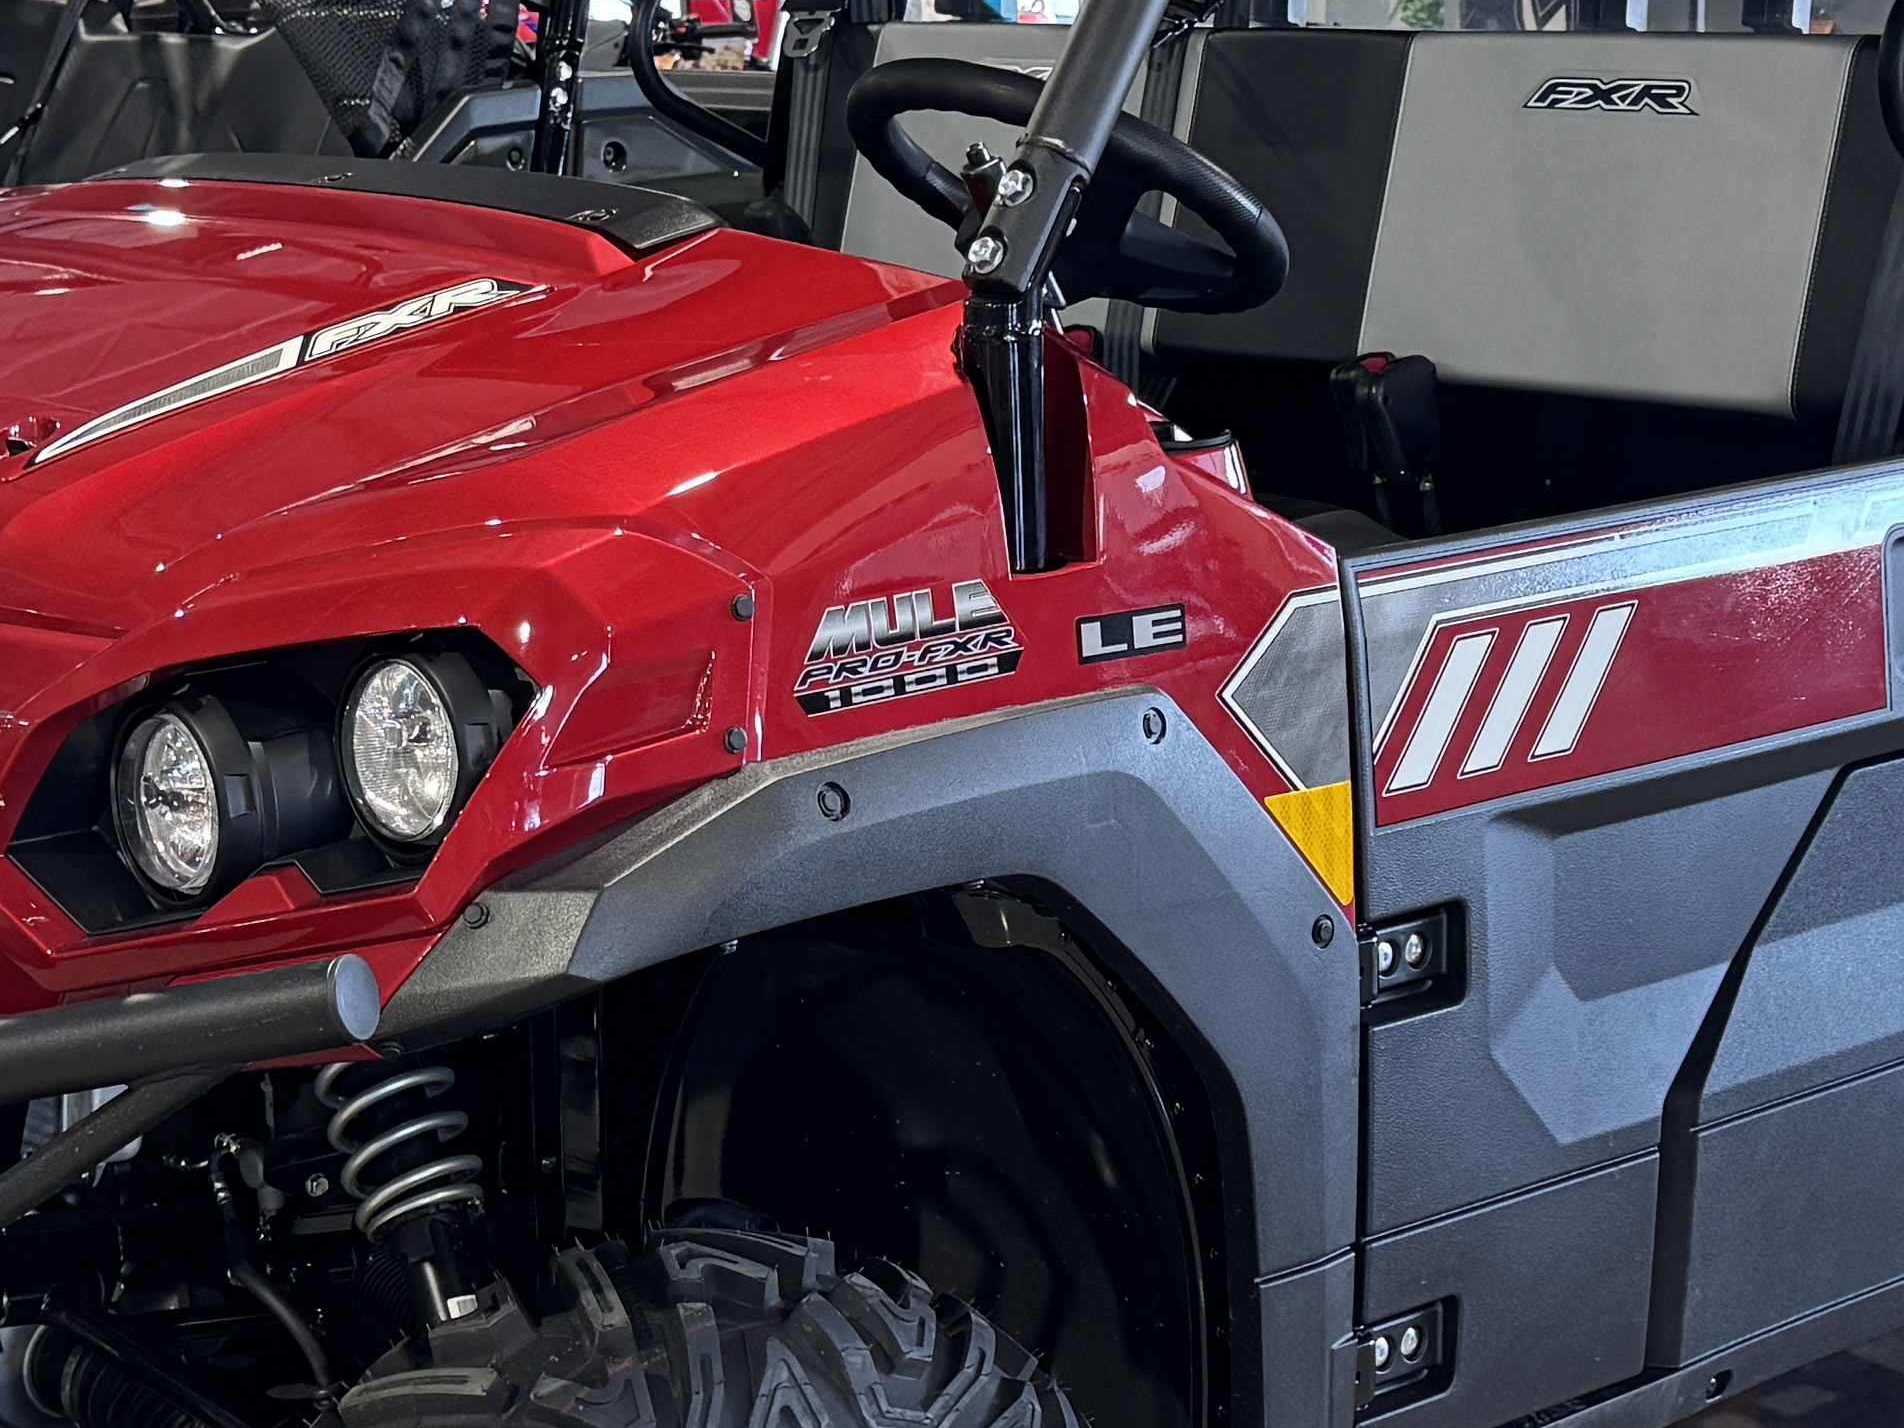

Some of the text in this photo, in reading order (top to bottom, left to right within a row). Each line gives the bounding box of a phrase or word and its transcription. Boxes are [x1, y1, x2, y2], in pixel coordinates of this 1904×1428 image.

[1523, 77, 1699, 116] FXR
[305, 278, 520, 362] FXR
[805, 578, 1008, 664] MULE
[1079, 609, 1184, 658] LE
[795, 627, 1019, 691] PRO-FXR
[825, 658, 999, 710] 1000
